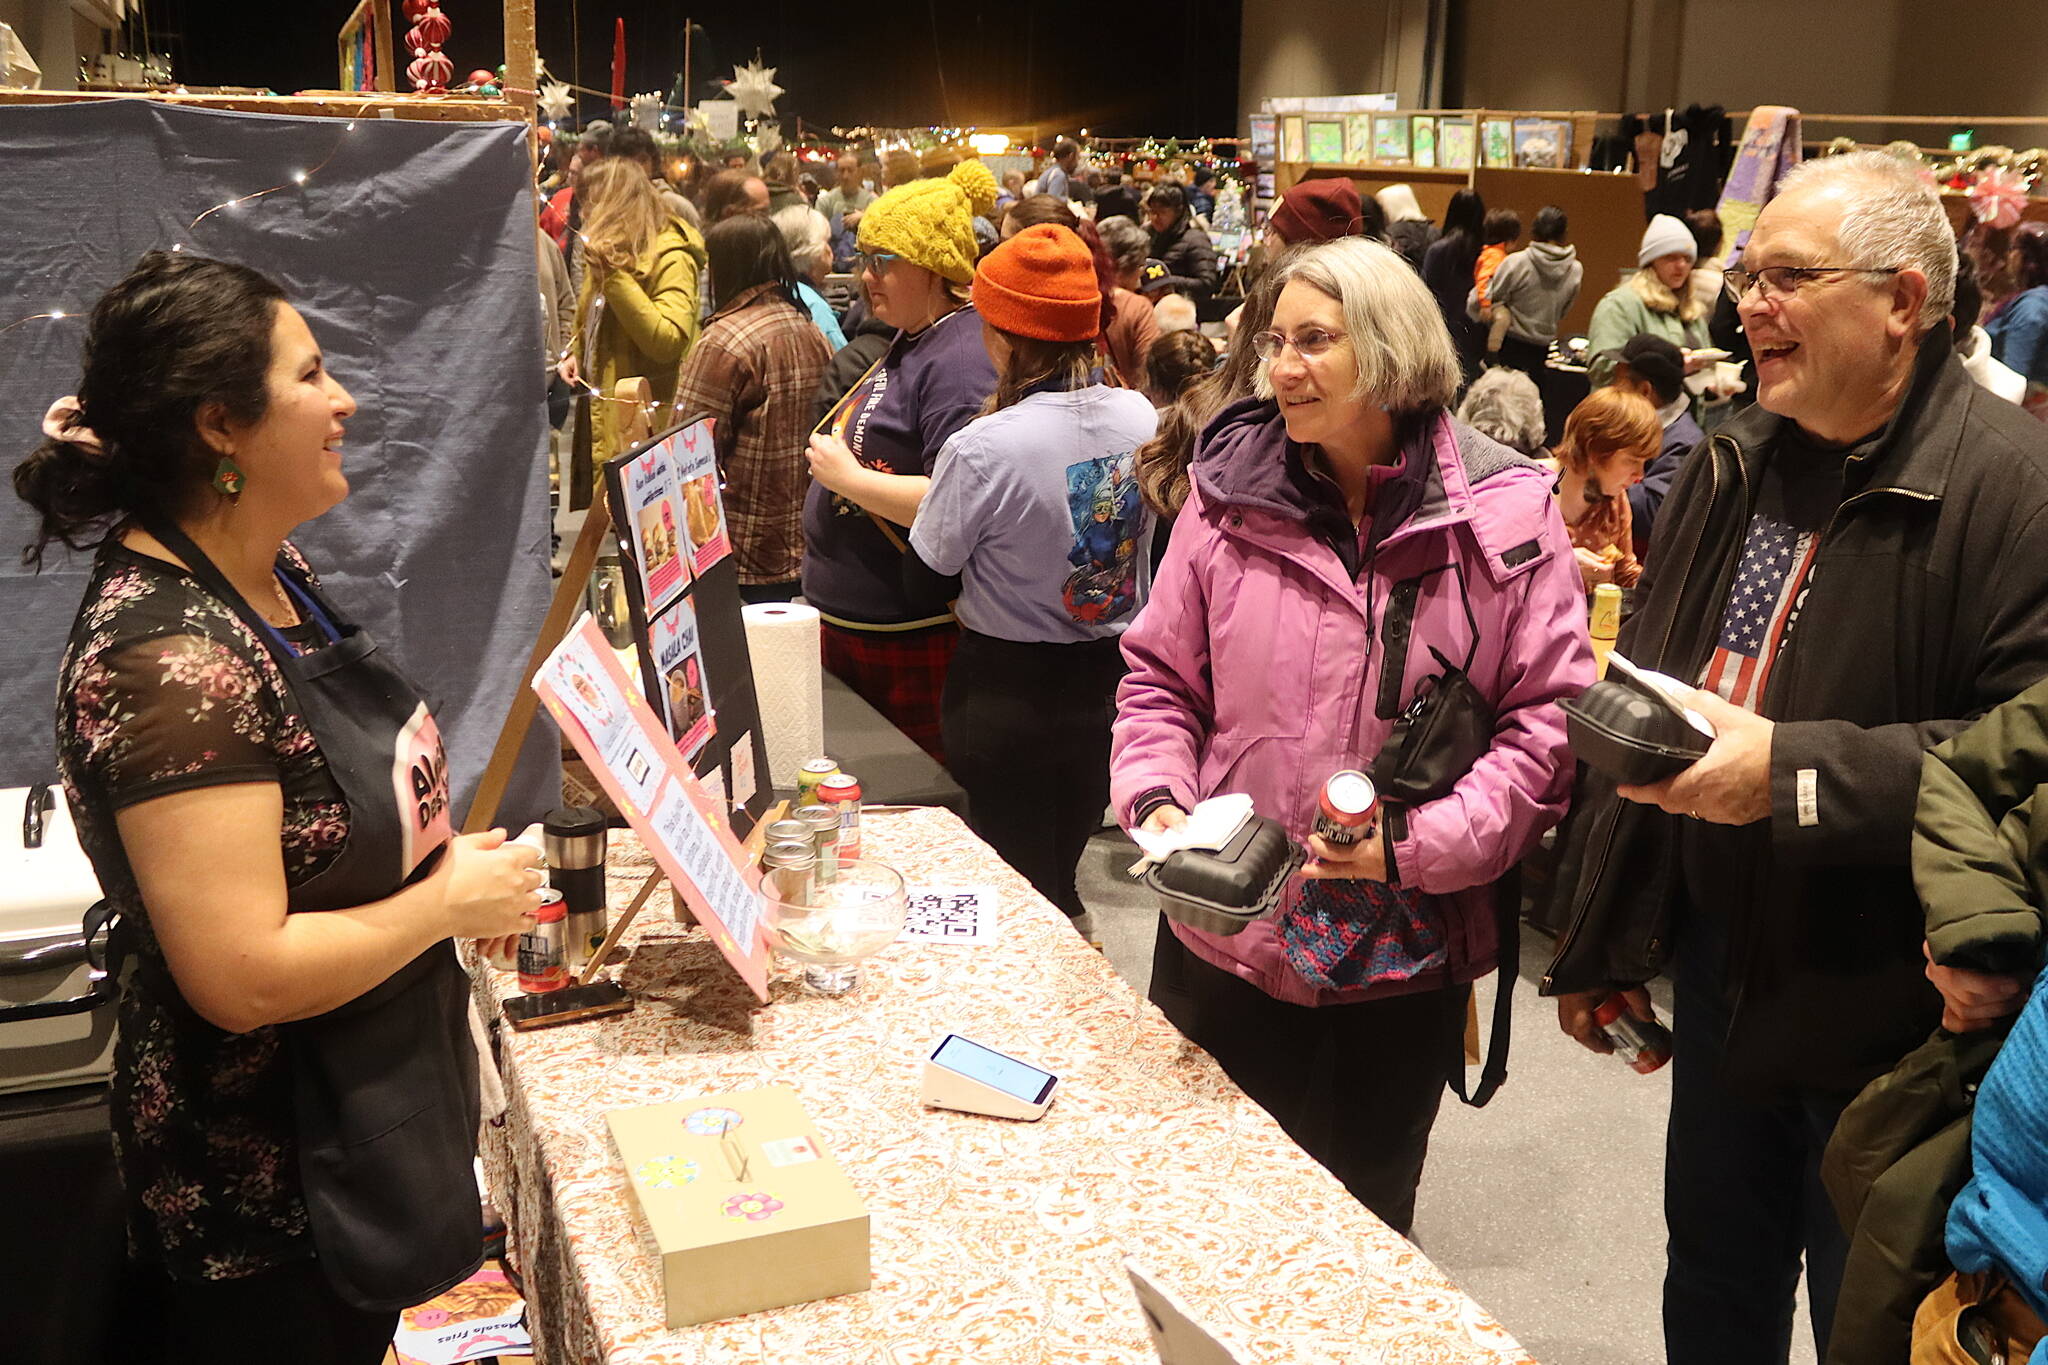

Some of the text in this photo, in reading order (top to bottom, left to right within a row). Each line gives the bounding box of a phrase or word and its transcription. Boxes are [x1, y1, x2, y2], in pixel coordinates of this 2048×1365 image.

[863, 393, 883, 411] FIRE
[660, 636, 682, 667] MASALA
[1318, 820, 1351, 844] POLAR
[437, 1322, 519, 1344] Masala Fries
